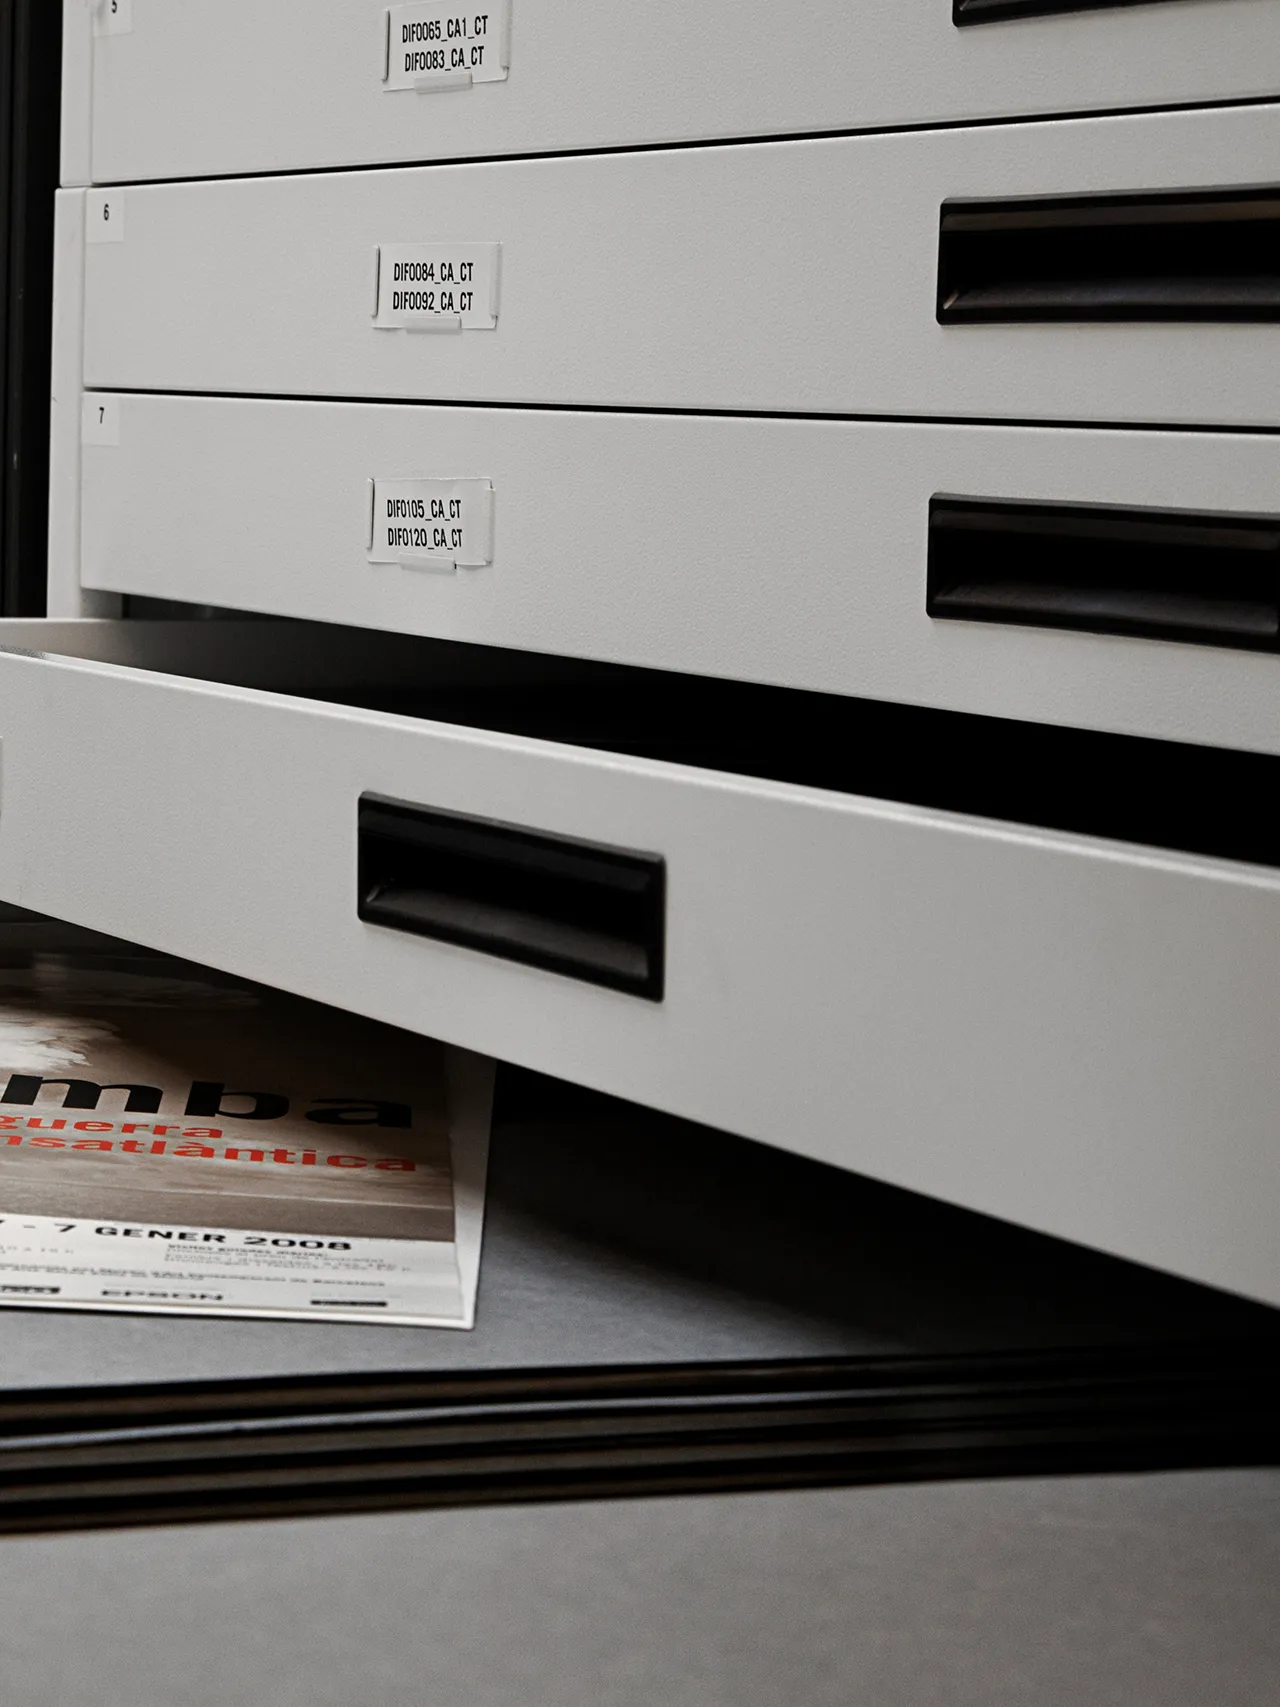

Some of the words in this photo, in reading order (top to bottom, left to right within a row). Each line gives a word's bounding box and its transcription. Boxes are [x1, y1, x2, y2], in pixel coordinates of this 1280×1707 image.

[402, 15, 488, 43] DIF0065_CA1_CT
[404, 46, 484, 71] DIF0083_CA_CT
[103, 203, 109, 220] 6
[393, 263, 474, 284] DIF0084_CA_CT
[392, 292, 473, 313] DIF0092_CA_CT
[99, 407, 105, 424] 7
[387, 499, 461, 521] DIF0105_CA_CT
[387, 528, 462, 550] DIF0120_CA_CT
[54, 1224, 76, 1233] 7
[95, 1226, 226, 1244] GENER
[243, 1236, 352, 1251] 2008
